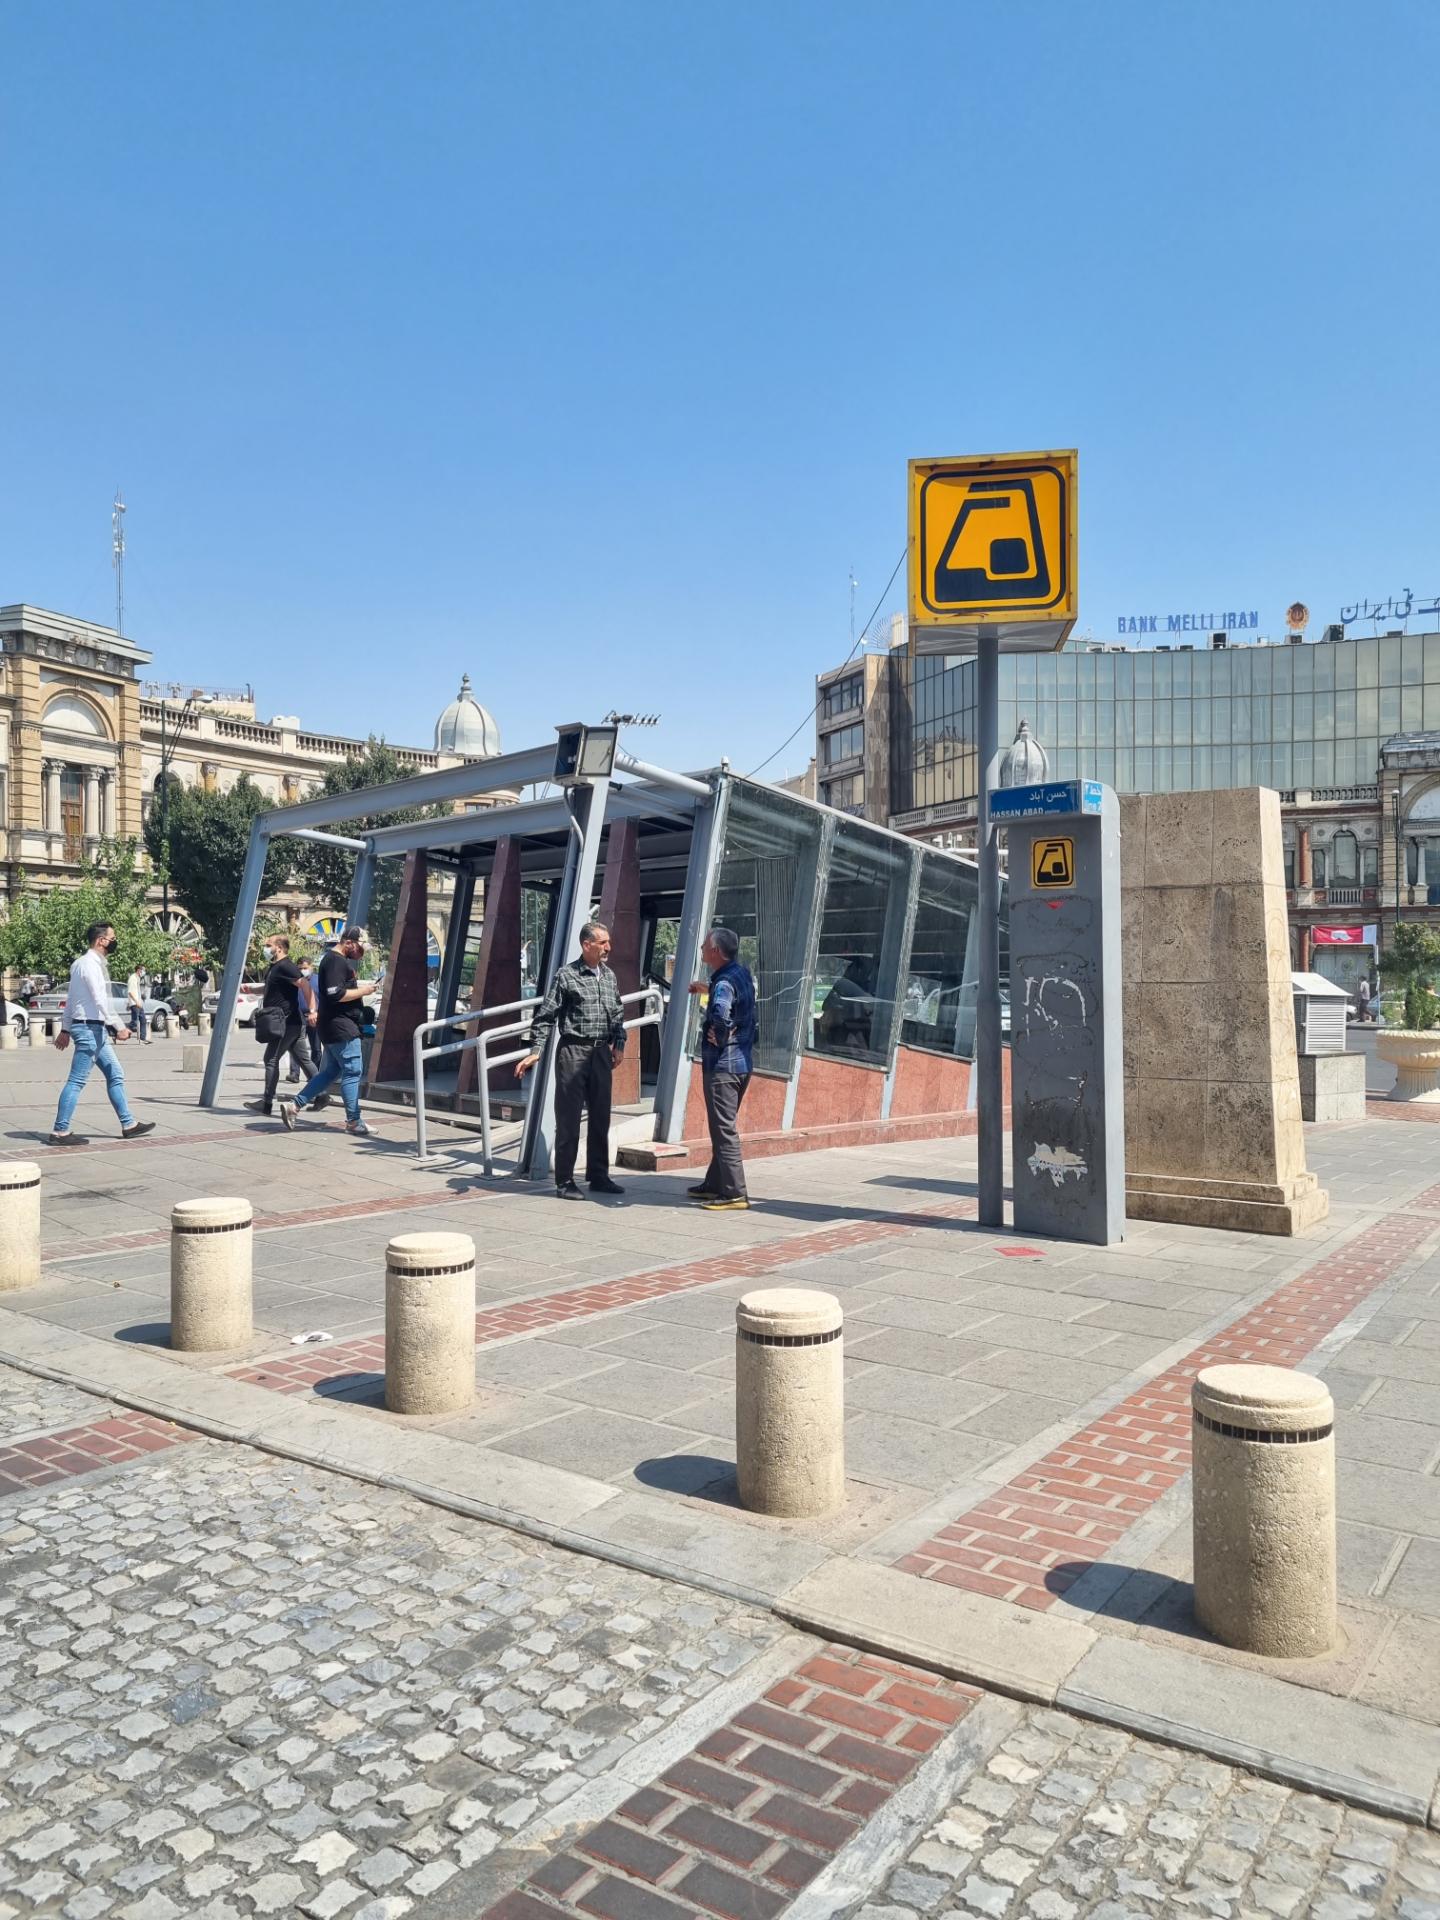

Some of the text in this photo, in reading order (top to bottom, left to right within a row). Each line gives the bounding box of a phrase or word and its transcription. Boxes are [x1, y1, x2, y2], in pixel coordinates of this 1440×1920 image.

[1341, 596, 1392, 624] ایران
[1118, 611, 1258, 633] BANK MELLI IRAN
[1029, 788, 1067, 803] حسن آباد
[990, 808, 1021, 818] HASSAN
[1023, 807, 1044, 817] ABAD
